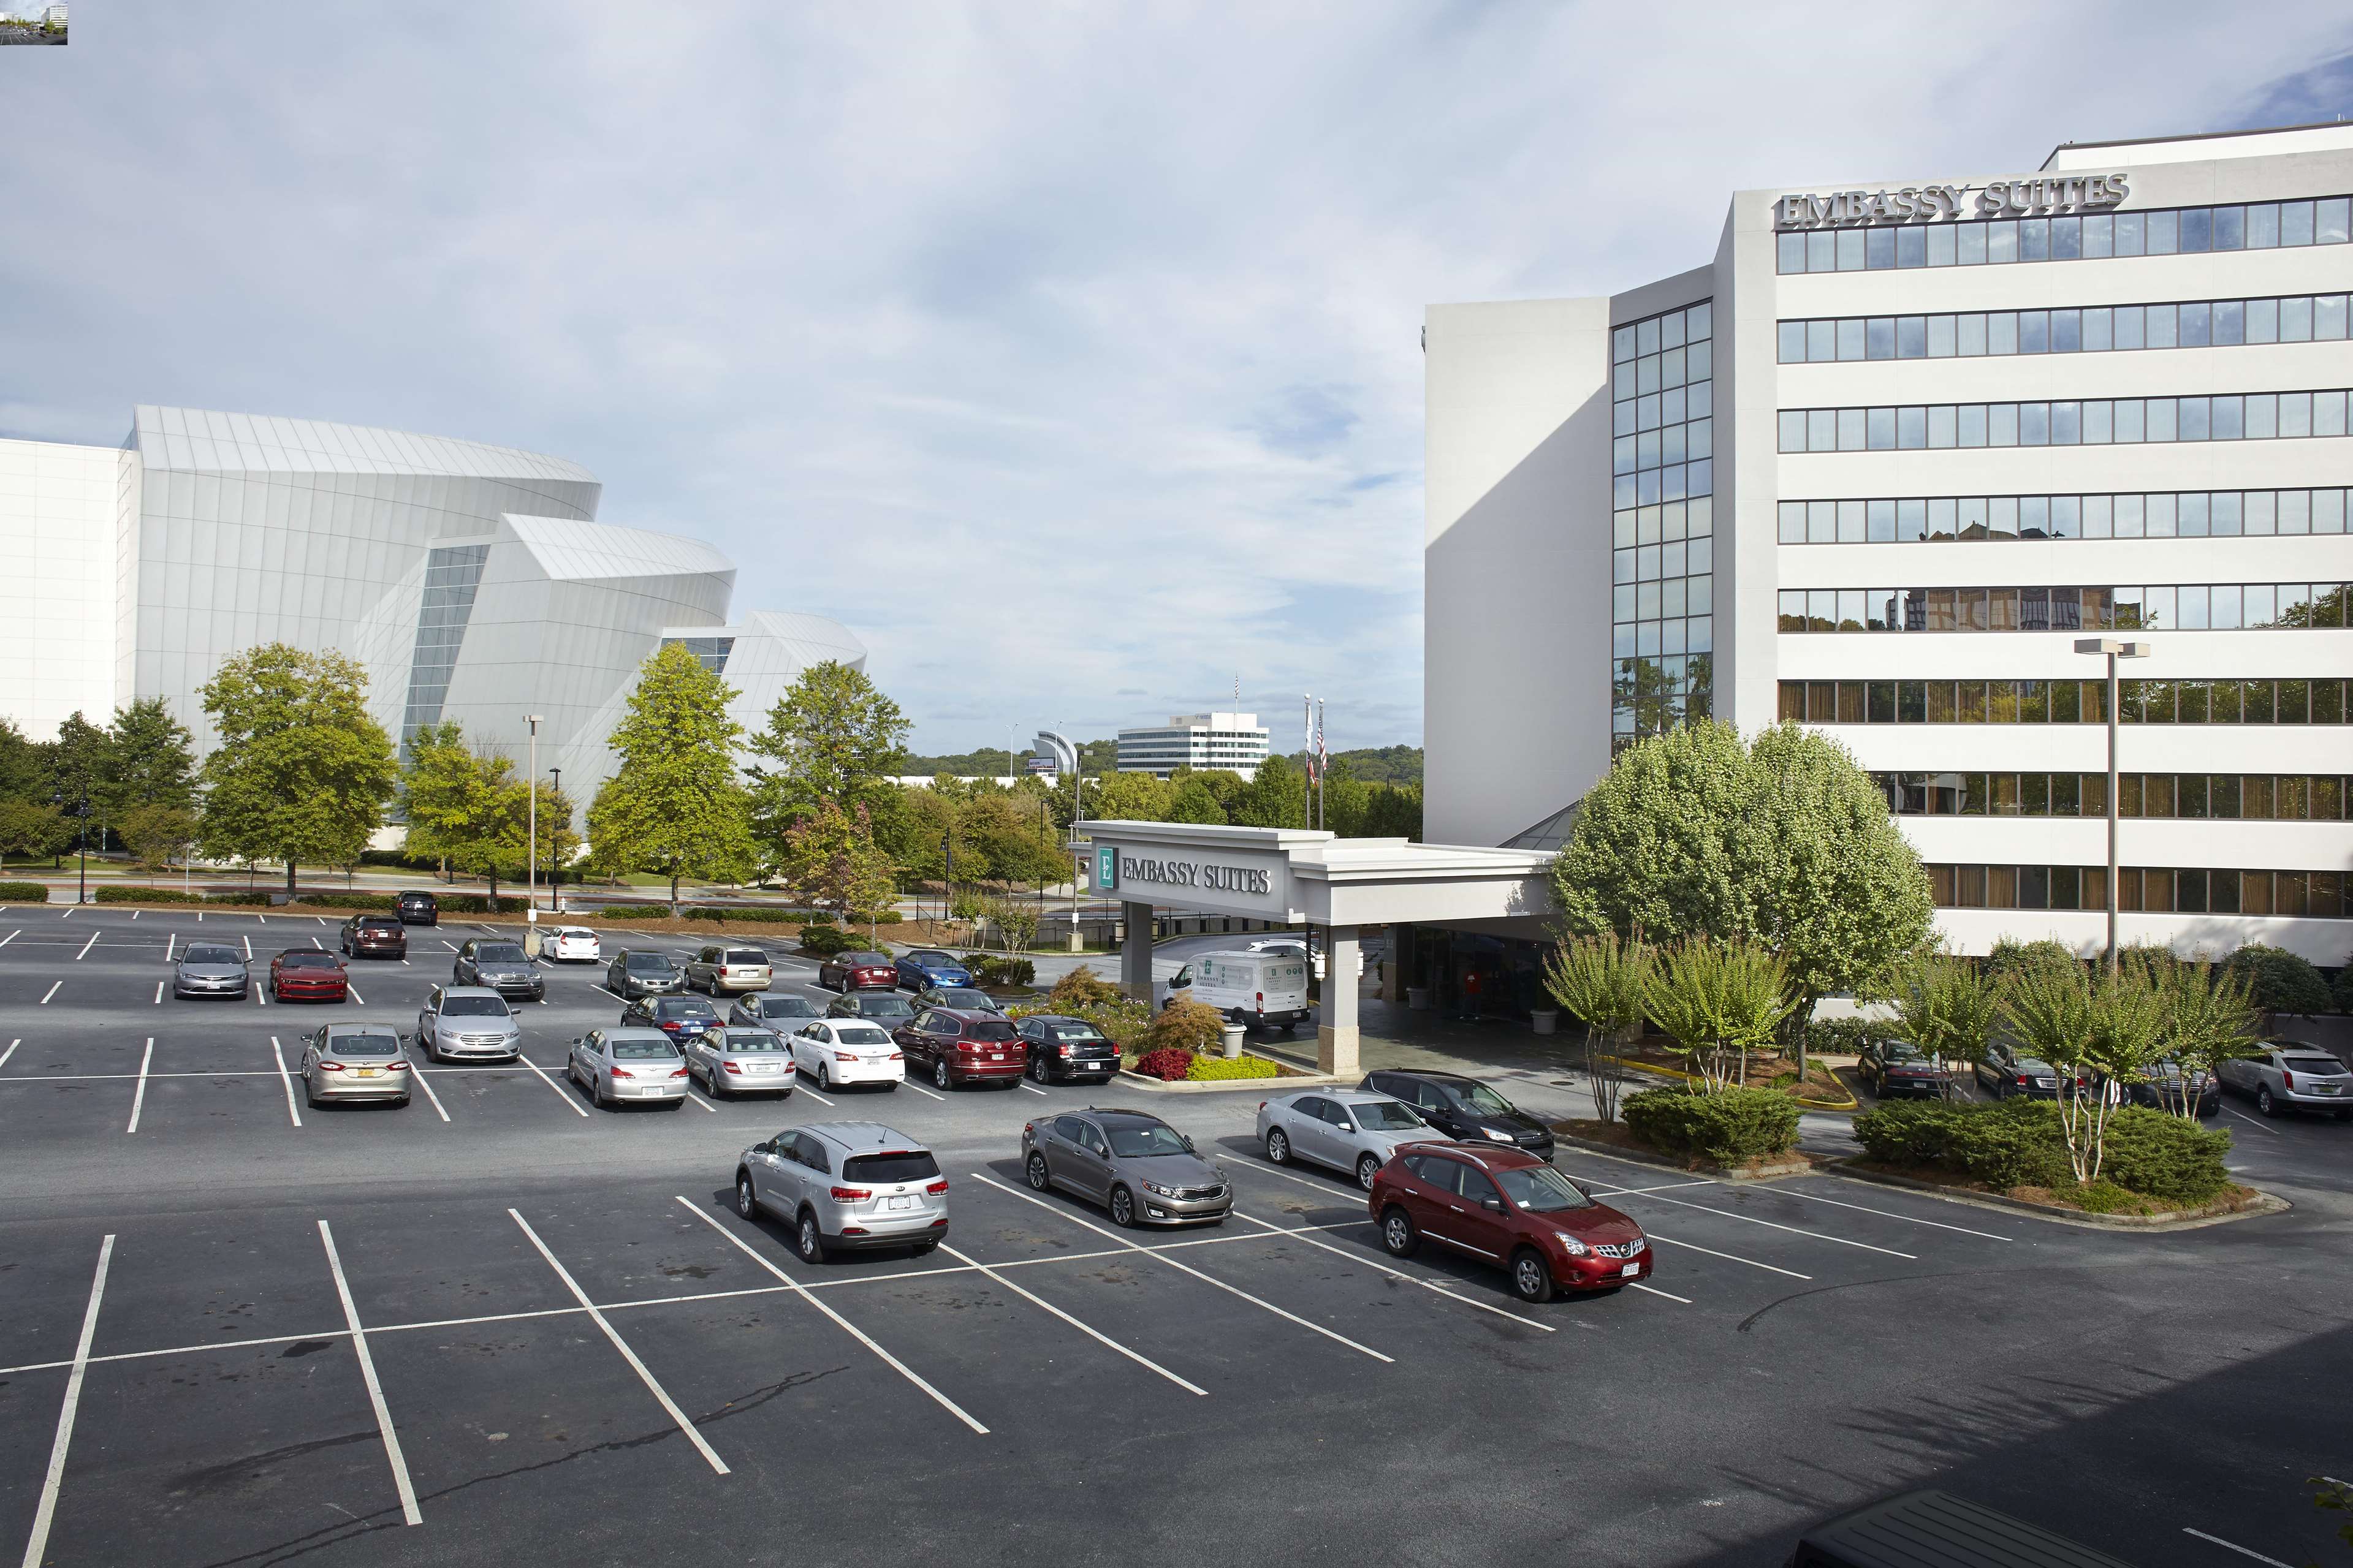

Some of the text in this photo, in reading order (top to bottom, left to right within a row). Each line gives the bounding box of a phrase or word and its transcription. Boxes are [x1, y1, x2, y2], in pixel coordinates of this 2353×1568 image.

[1779, 173, 2130, 224] EMBASSY SUITES
[1122, 857, 1271, 895] EMBASSY SUITES
